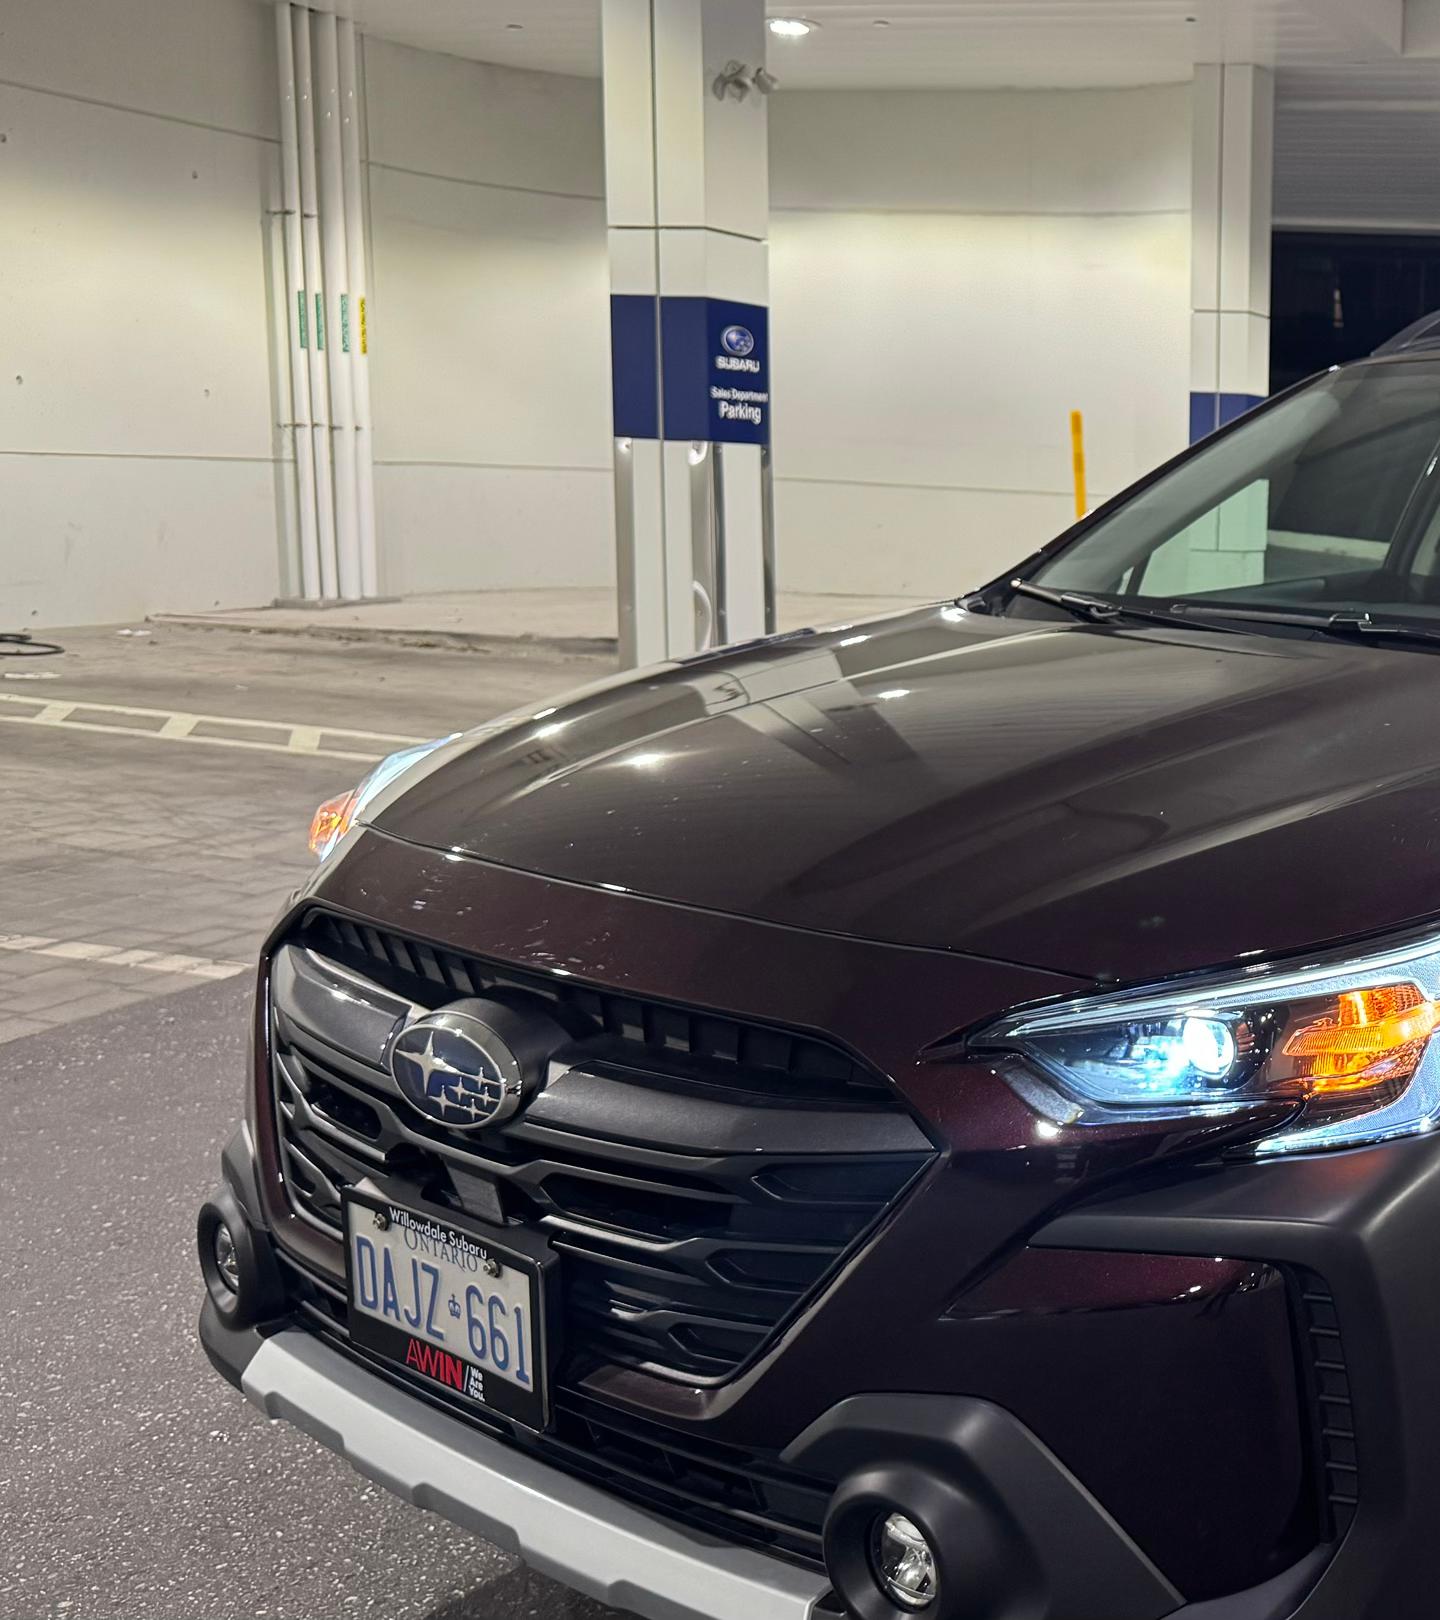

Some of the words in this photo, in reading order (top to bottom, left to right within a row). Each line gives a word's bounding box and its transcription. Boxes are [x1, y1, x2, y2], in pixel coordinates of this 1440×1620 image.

[715, 355, 761, 374] SUBARU
[719, 400, 762, 425] Parking
[389, 1206, 447, 1242] Willowdale
[449, 1231, 488, 1259] Subaru
[404, 1228, 478, 1273] ONTARIO
[356, 1235, 445, 1341] DAJZ
[465, 1285, 530, 1385] 661
[406, 1338, 463, 1391] AWIN
[470, 1366, 484, 1381] We
[469, 1377, 484, 1391] Are
